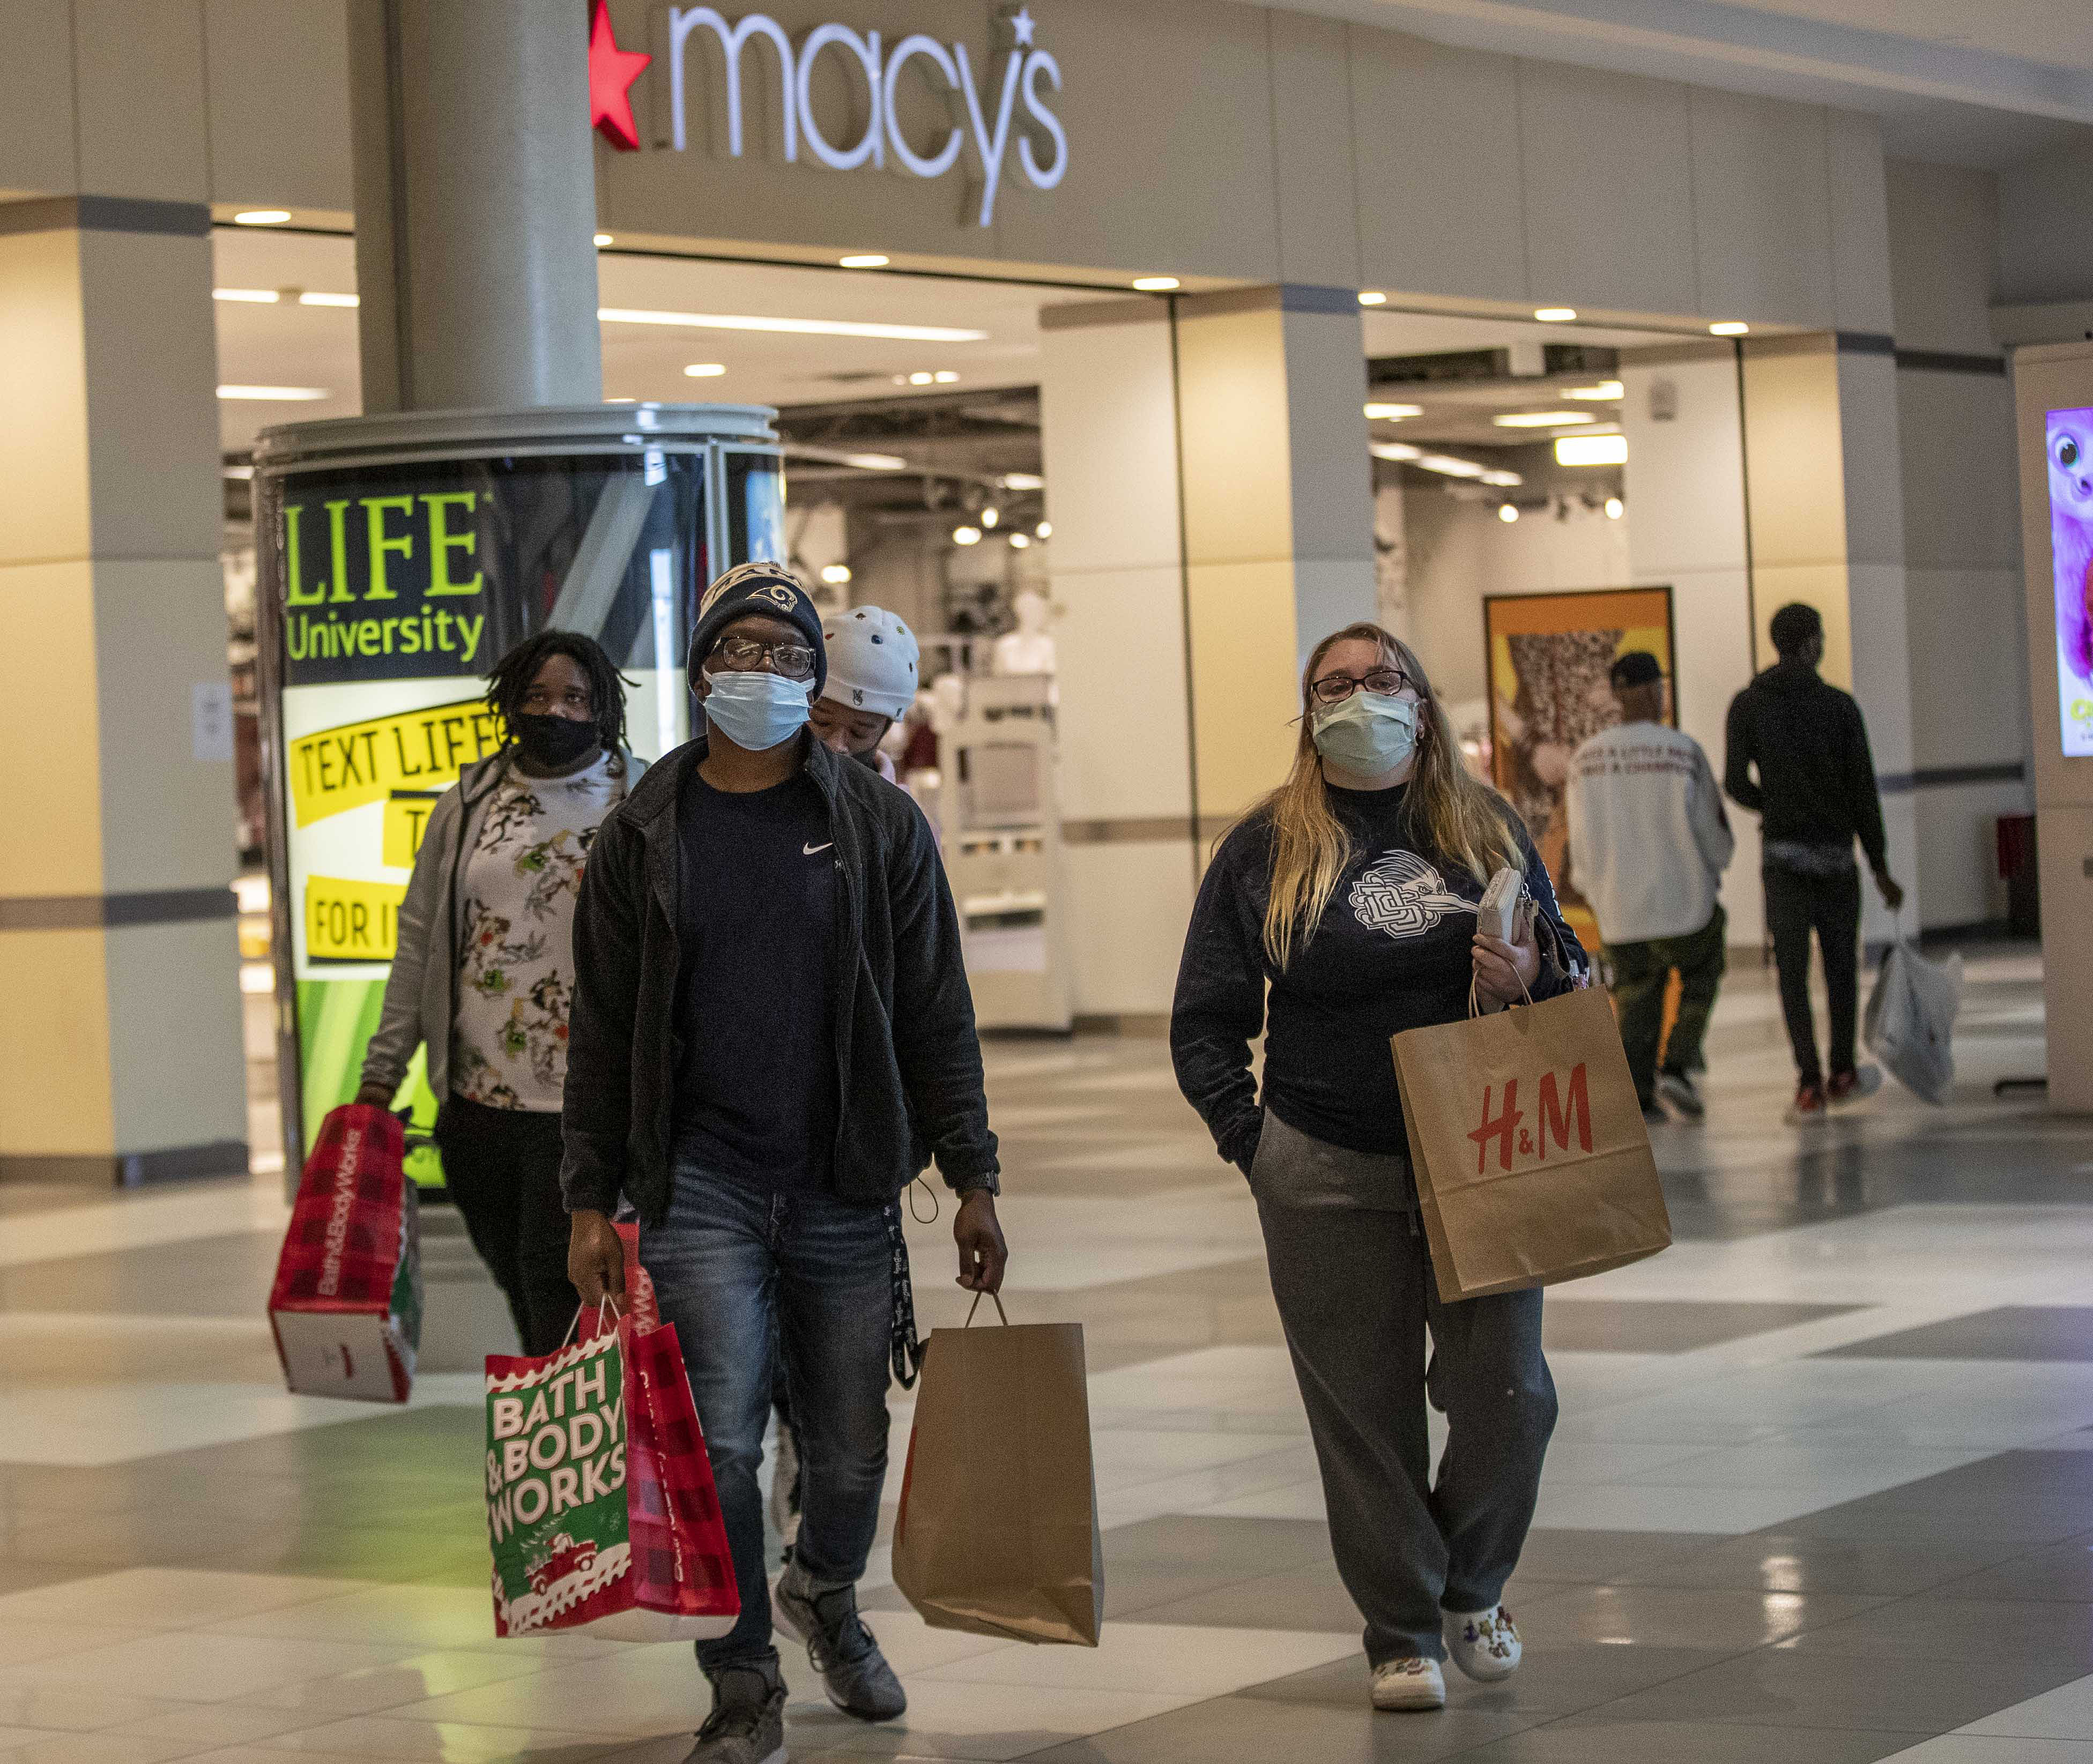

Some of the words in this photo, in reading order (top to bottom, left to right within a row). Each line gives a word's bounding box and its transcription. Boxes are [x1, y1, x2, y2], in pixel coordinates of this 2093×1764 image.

[284, 491, 484, 606] LIFE
[286, 605, 485, 663] University
[299, 731, 380, 795] TEXT
[316, 900, 371, 948] FOR
[1467, 1062, 1593, 1175] H&M
[493, 1358, 606, 1441] BATH
[489, 1442, 627, 1544] WORKS
